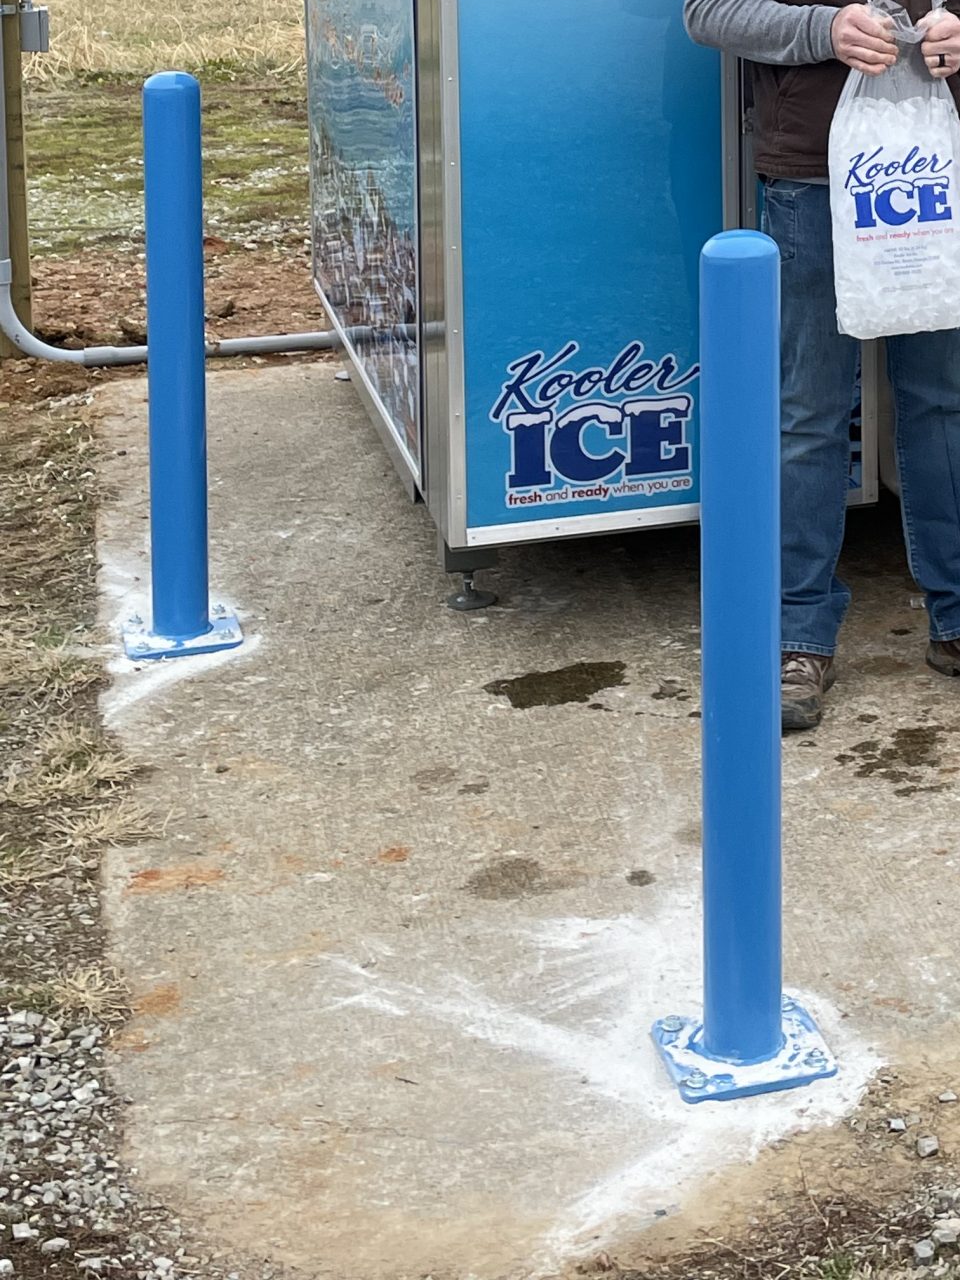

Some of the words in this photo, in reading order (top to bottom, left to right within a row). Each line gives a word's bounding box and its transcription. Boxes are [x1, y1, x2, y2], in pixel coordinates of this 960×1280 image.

[844, 145, 953, 189] Kooler
[850, 176, 953, 229] ICE
[856, 234, 874, 243] fresh
[889, 231, 911, 240] ready
[492, 342, 700, 420] Kooler
[506, 396, 691, 489] ICE
[508, 491, 542, 506] fresh
[546, 488, 568, 502] and
[571, 485, 610, 500] ready
[613, 480, 644, 495] when
[647, 480, 669, 494] you
[672, 478, 690, 488] are
